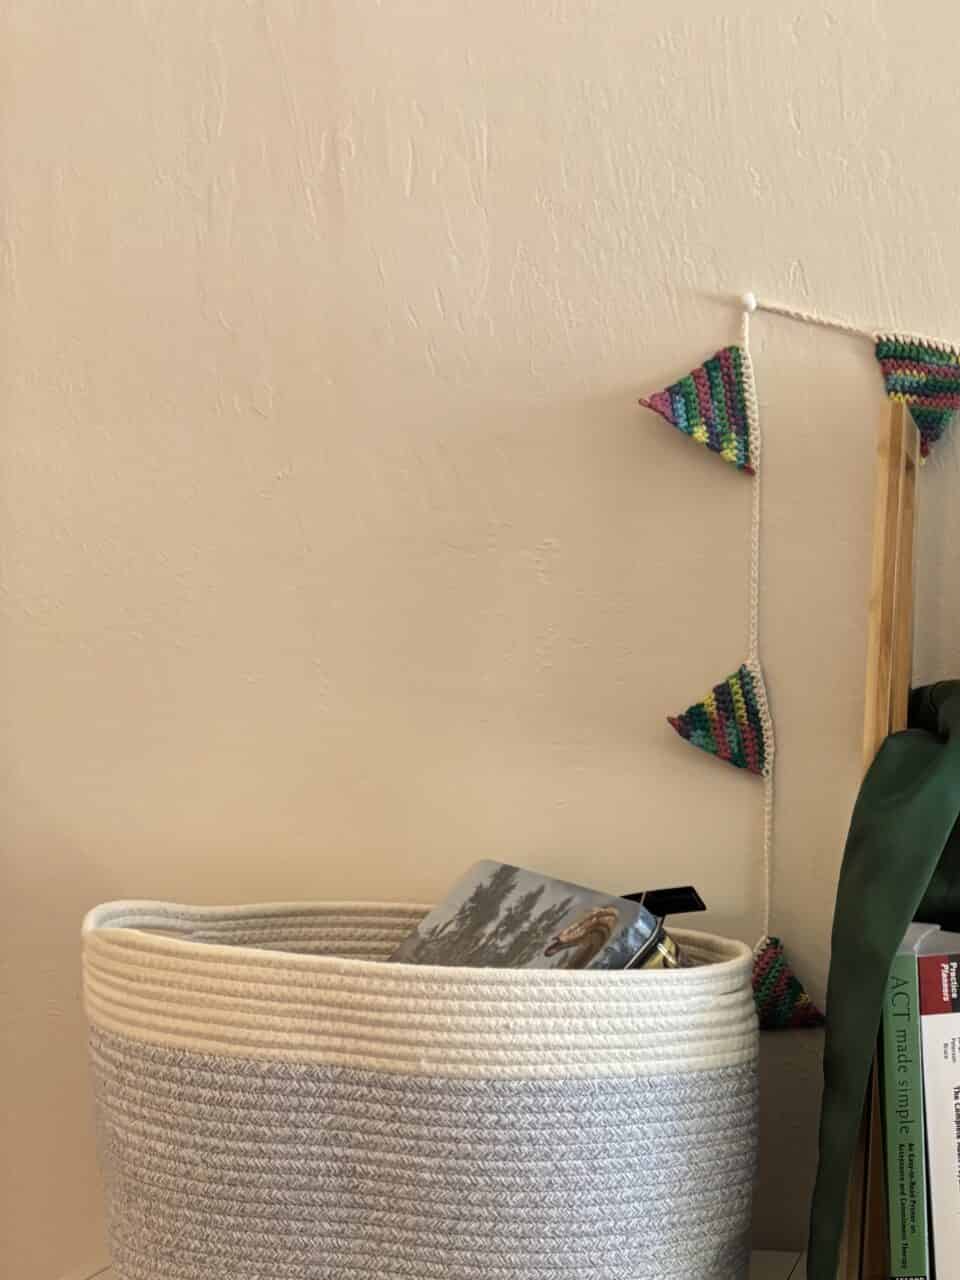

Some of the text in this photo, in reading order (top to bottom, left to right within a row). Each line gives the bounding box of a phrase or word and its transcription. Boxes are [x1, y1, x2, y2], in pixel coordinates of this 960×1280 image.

[890, 976, 915, 1136] ACT made simple
[953, 1086, 960, 1100] The
